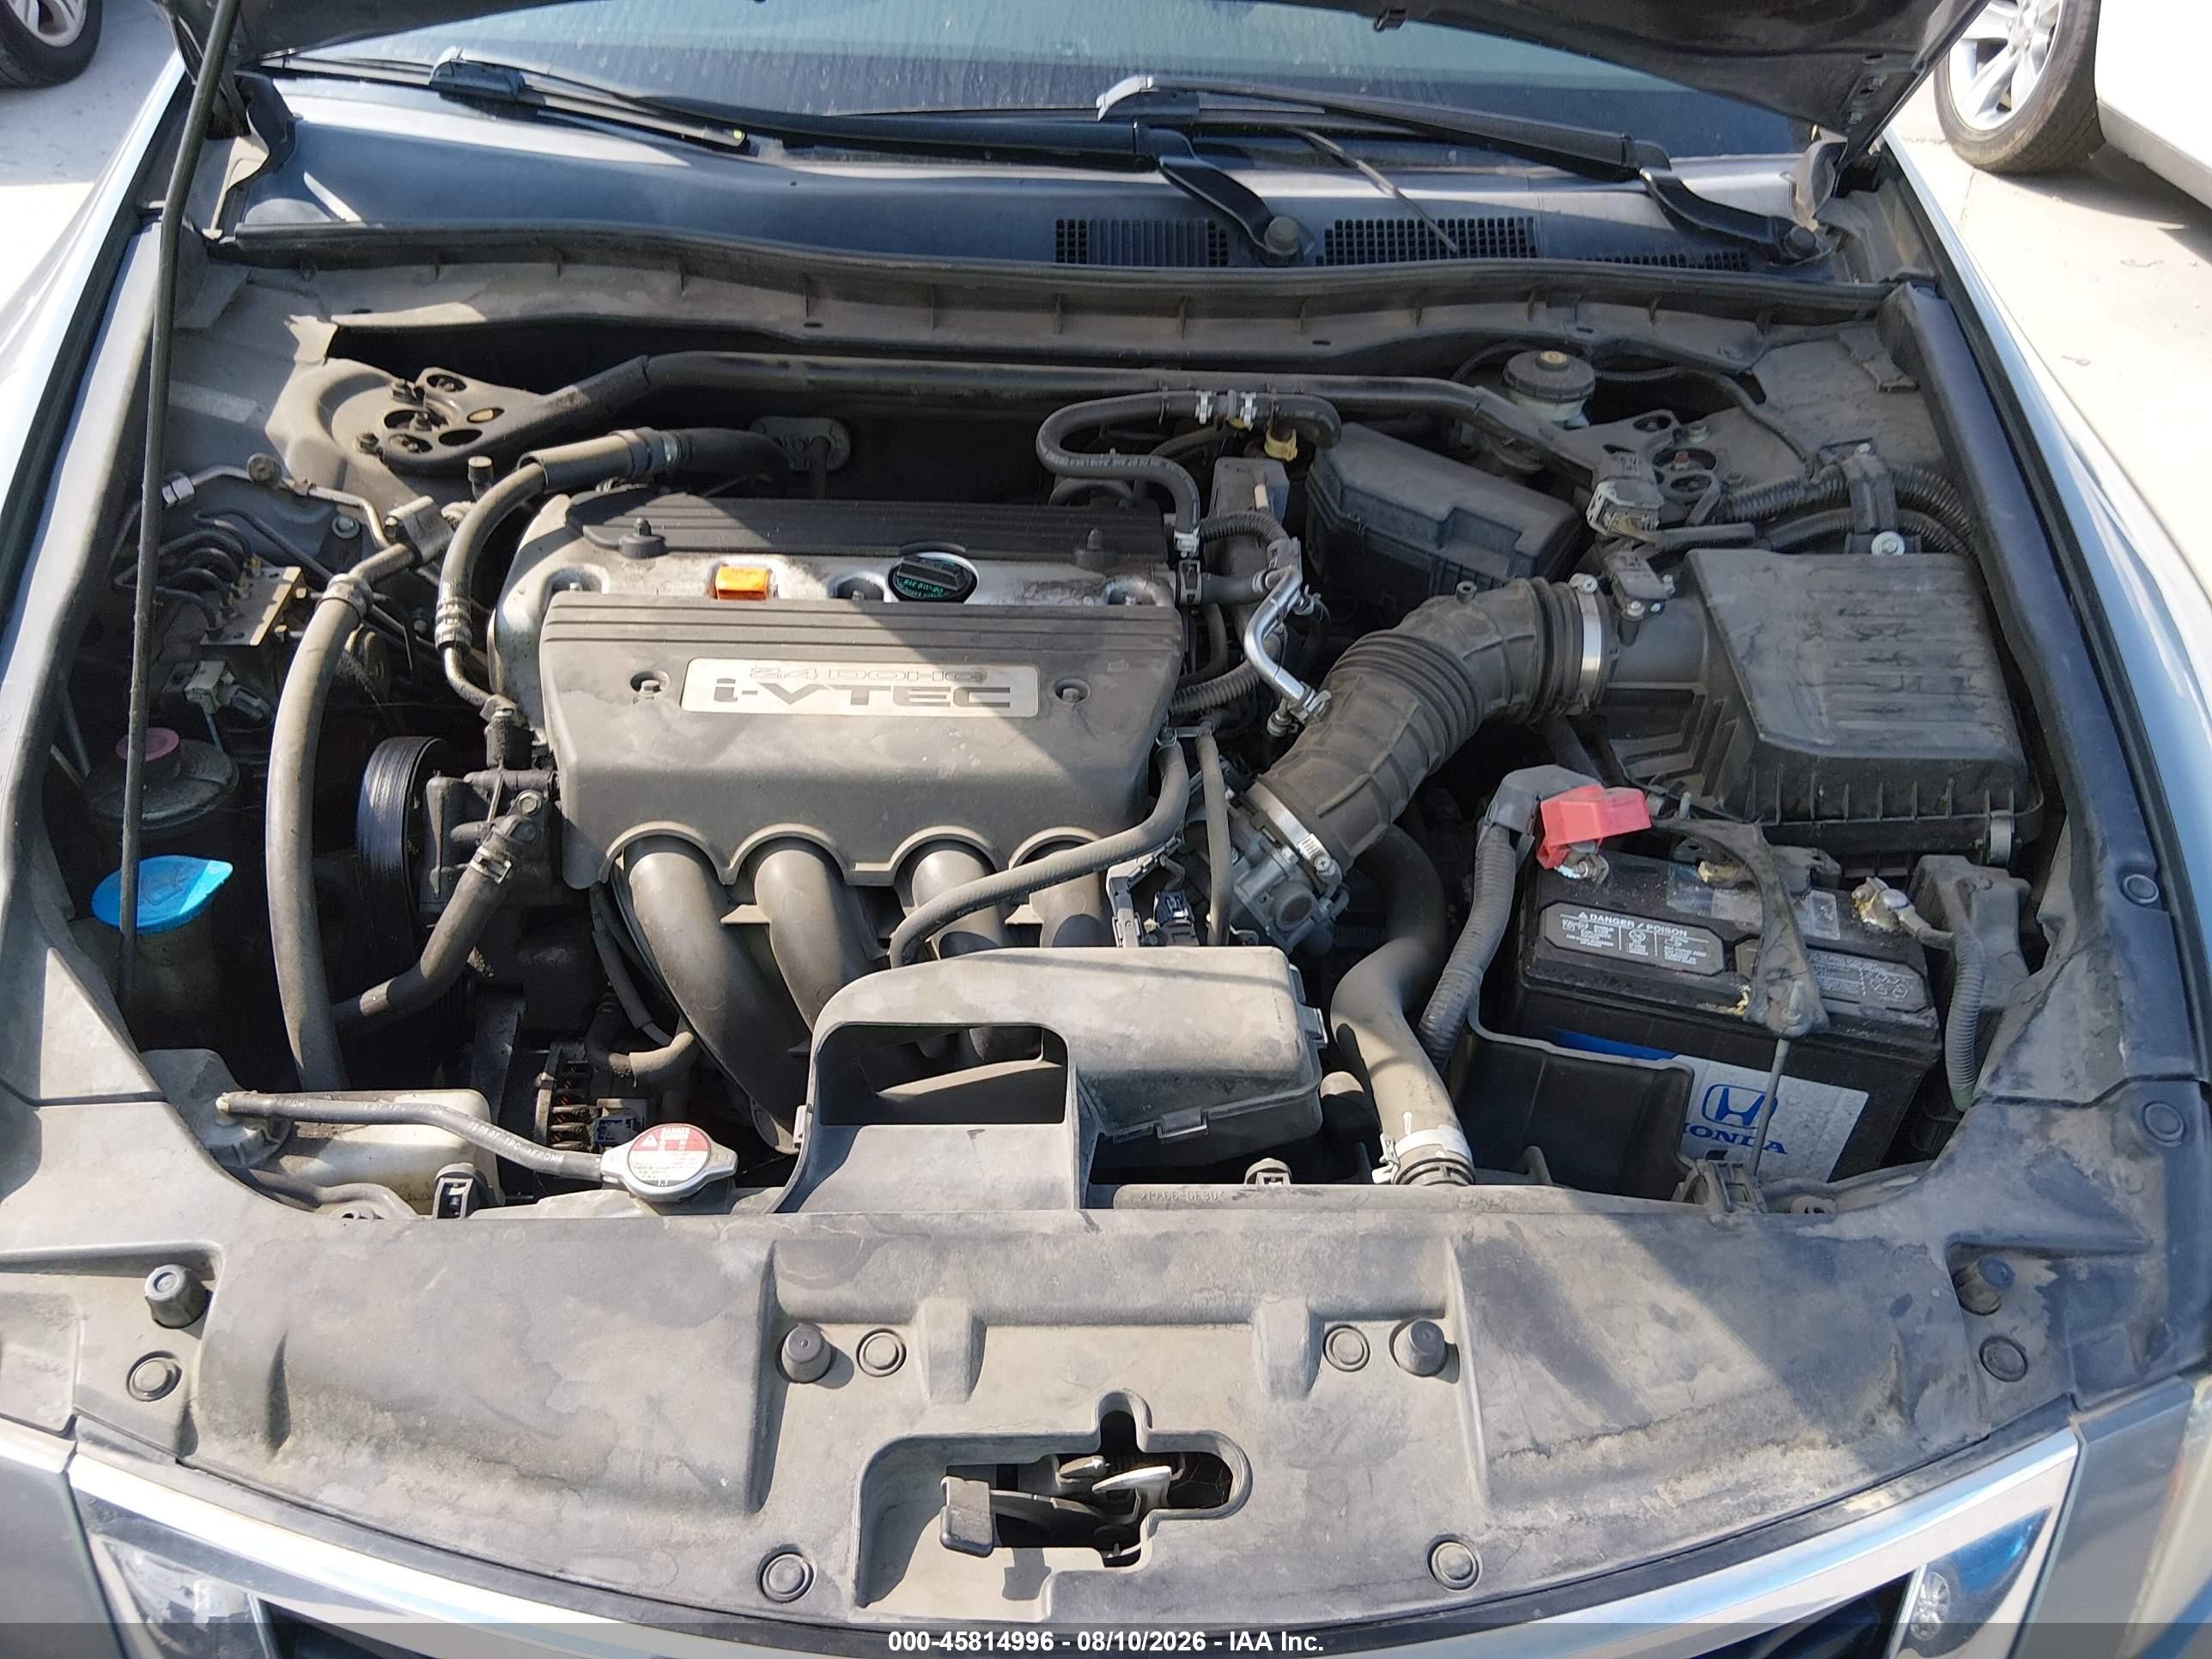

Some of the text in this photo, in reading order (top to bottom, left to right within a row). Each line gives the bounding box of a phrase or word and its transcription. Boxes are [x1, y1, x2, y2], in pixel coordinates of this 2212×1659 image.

[749, 666, 988, 684] 2.4 DOHC
[714, 678, 1011, 708] i-VTEC
[1589, 913, 1635, 928] DANGER
[1646, 923, 1687, 937] POISON
